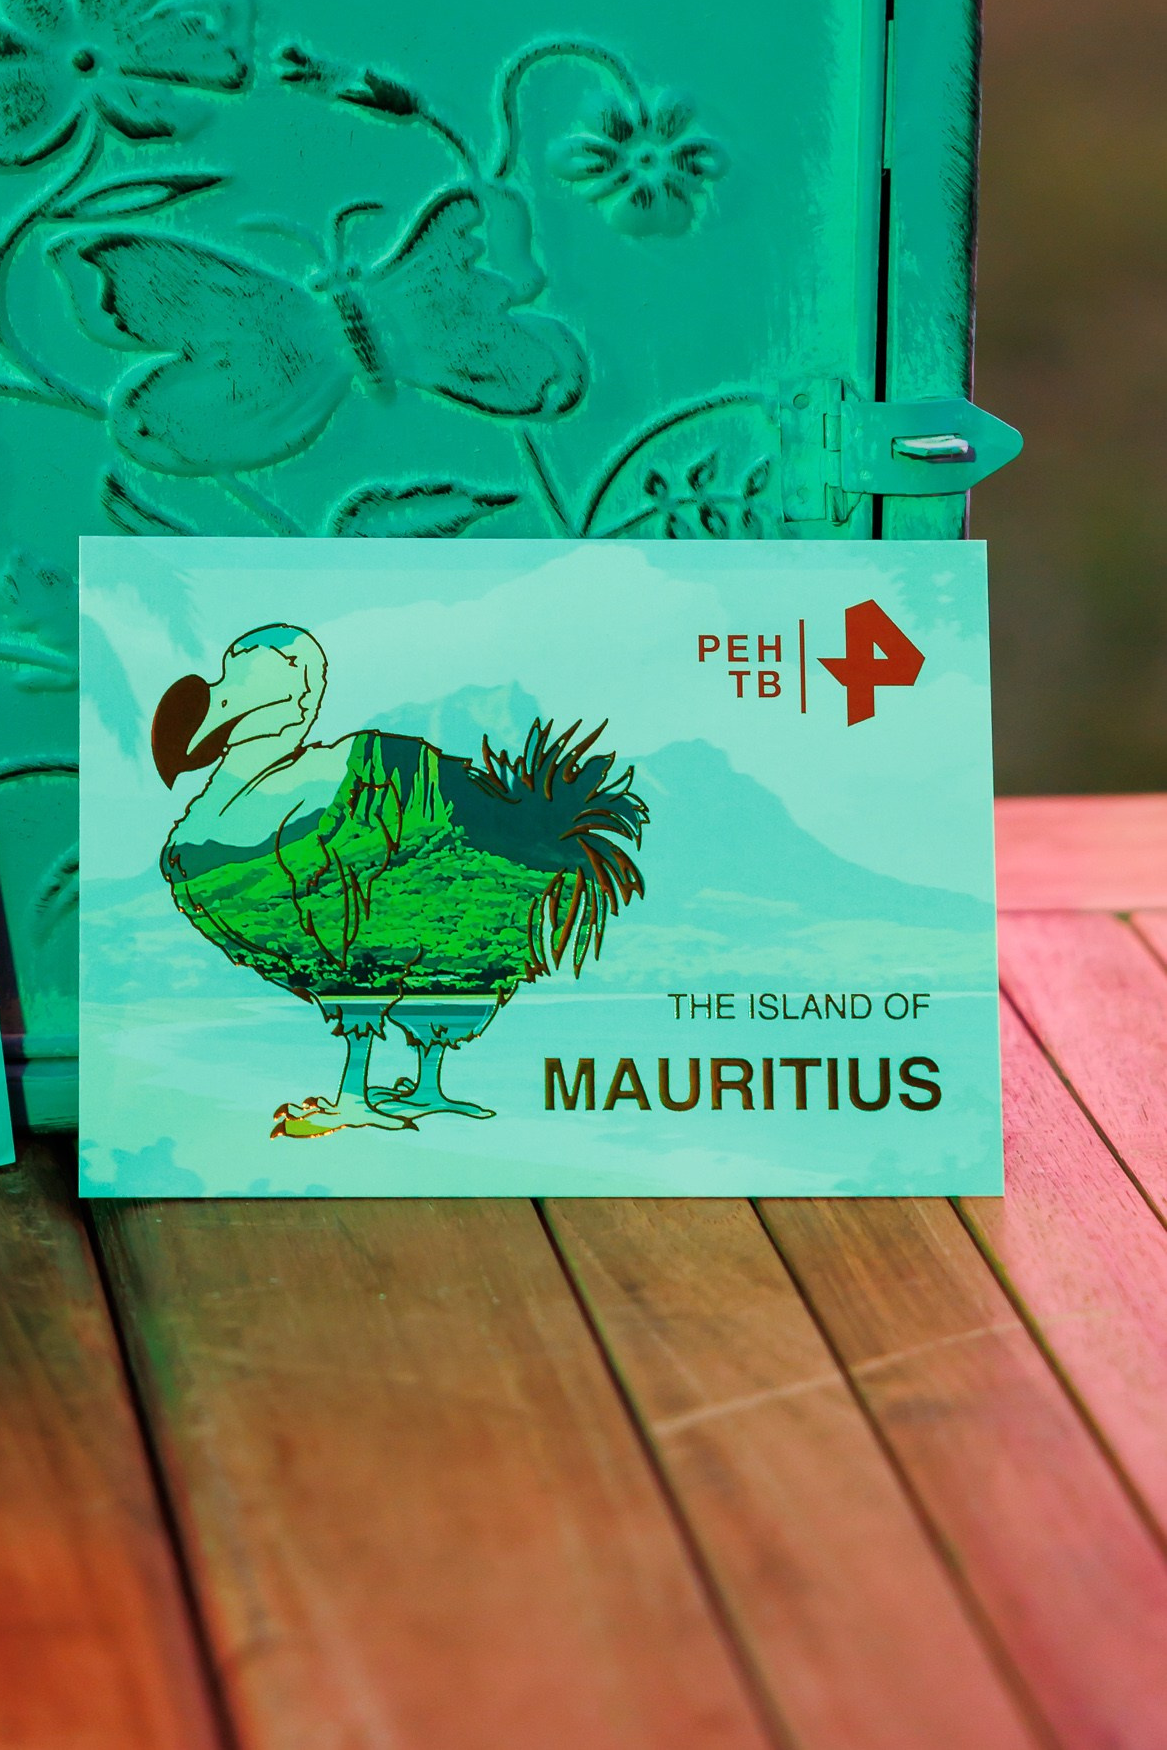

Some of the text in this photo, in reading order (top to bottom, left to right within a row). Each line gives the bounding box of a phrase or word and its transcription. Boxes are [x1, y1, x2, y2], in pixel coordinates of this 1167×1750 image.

[667, 993, 931, 1020] THE ISLAND OF
[544, 1056, 942, 1112] MAURITIUS
